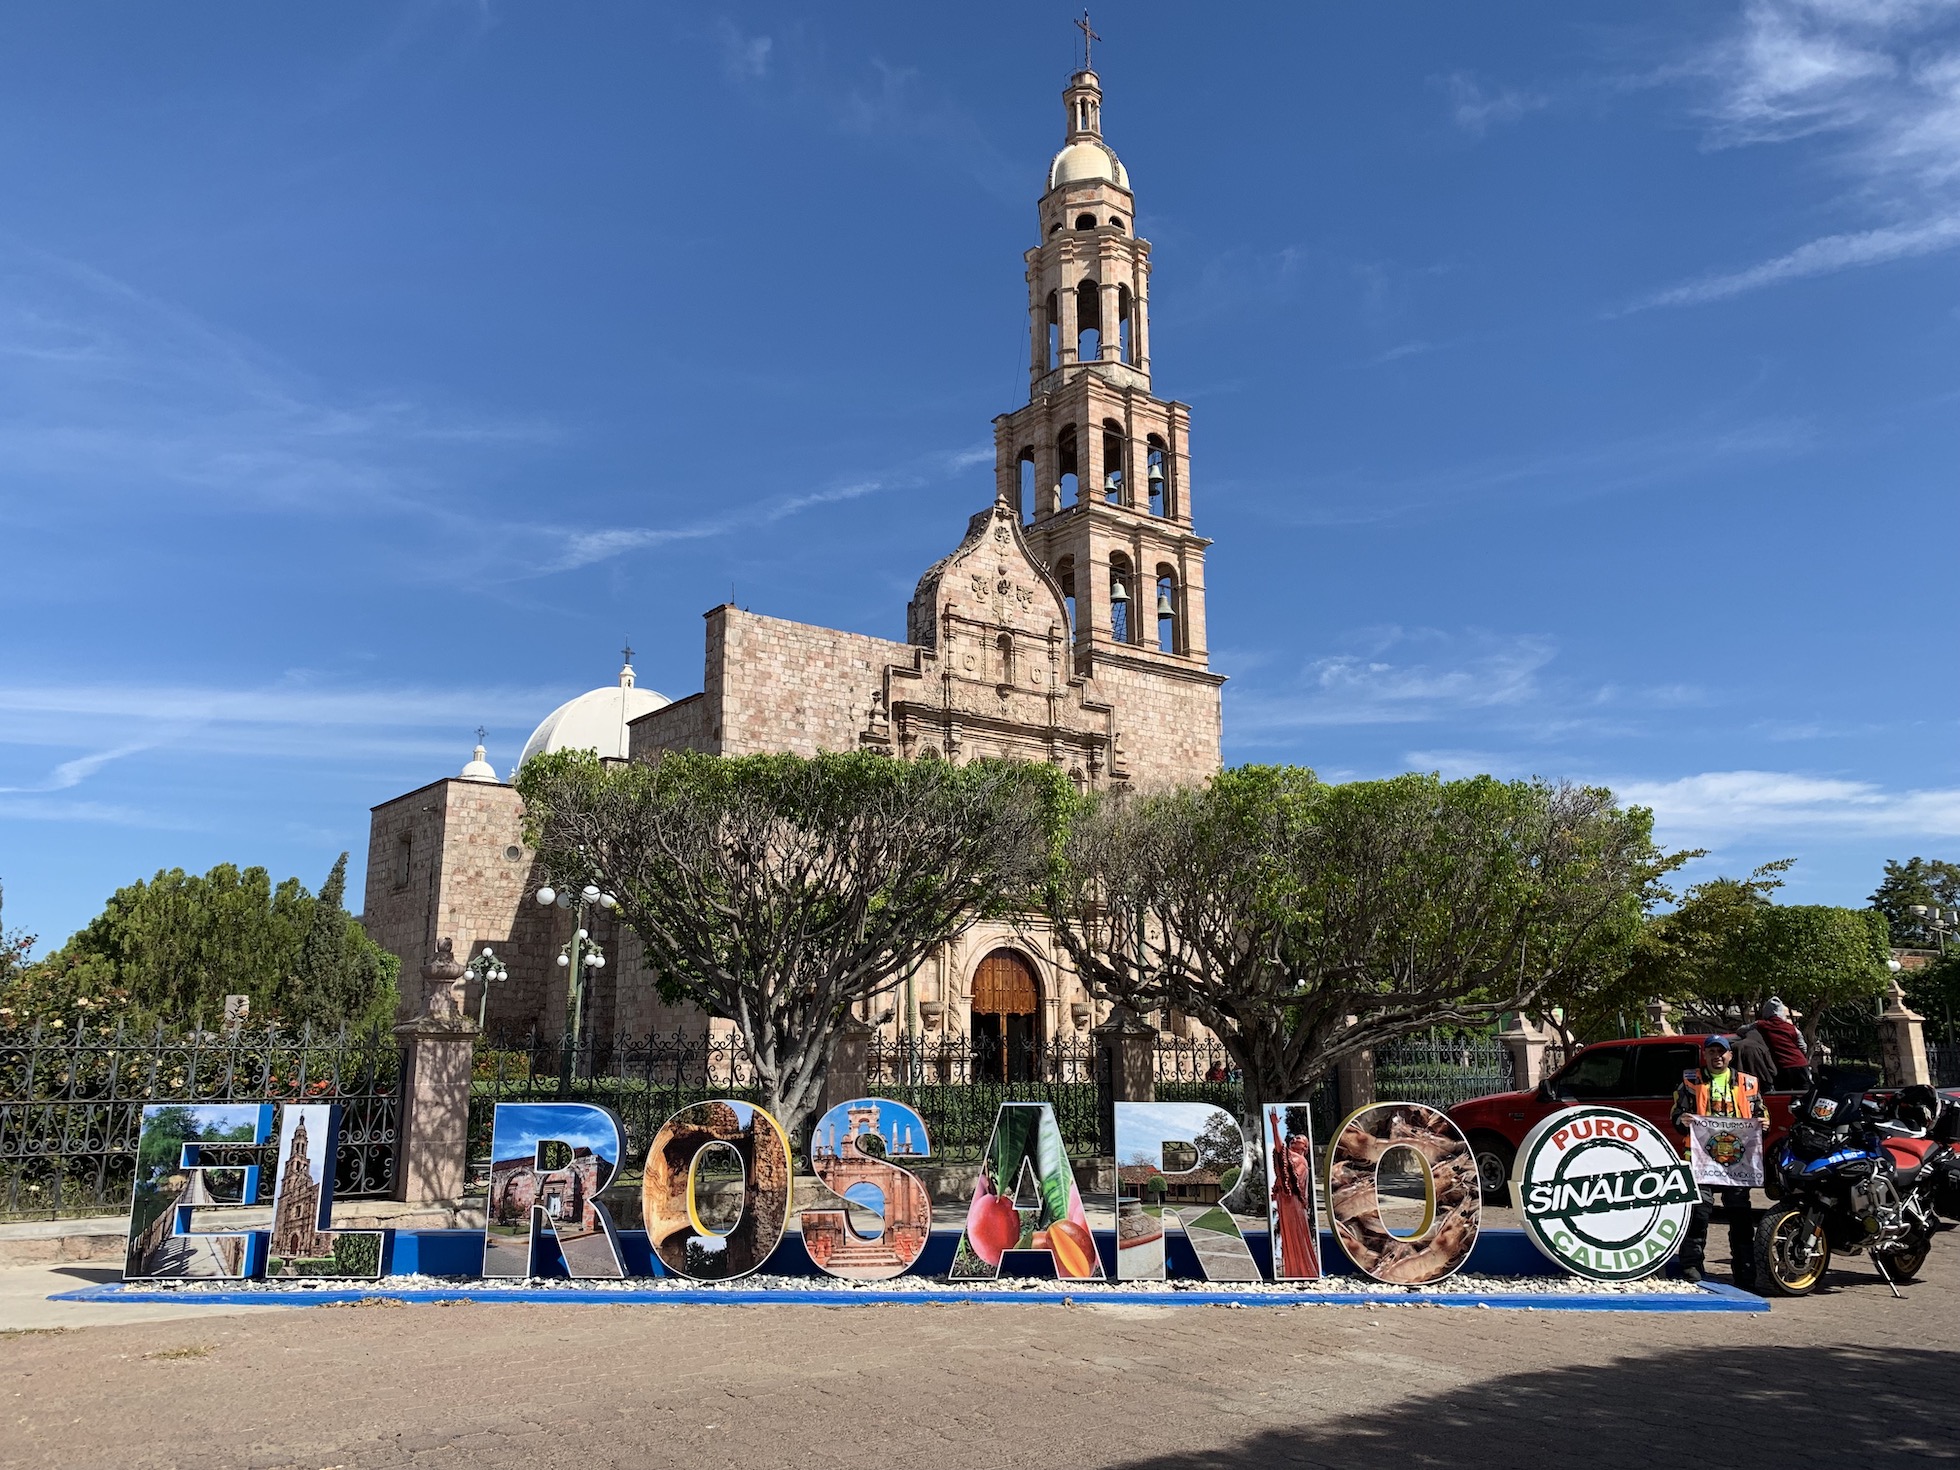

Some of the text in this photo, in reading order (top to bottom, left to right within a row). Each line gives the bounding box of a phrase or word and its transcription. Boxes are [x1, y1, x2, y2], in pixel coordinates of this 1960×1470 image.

[1551, 1119, 1639, 1151] PURO
[1693, 1120, 1754, 1130] MOTO TURISTA
[123, 1098, 1482, 1285] EL ROSARIO
[1527, 1169, 1688, 1214] SINALOA
[1553, 1218, 1678, 1270] CALIDAD
